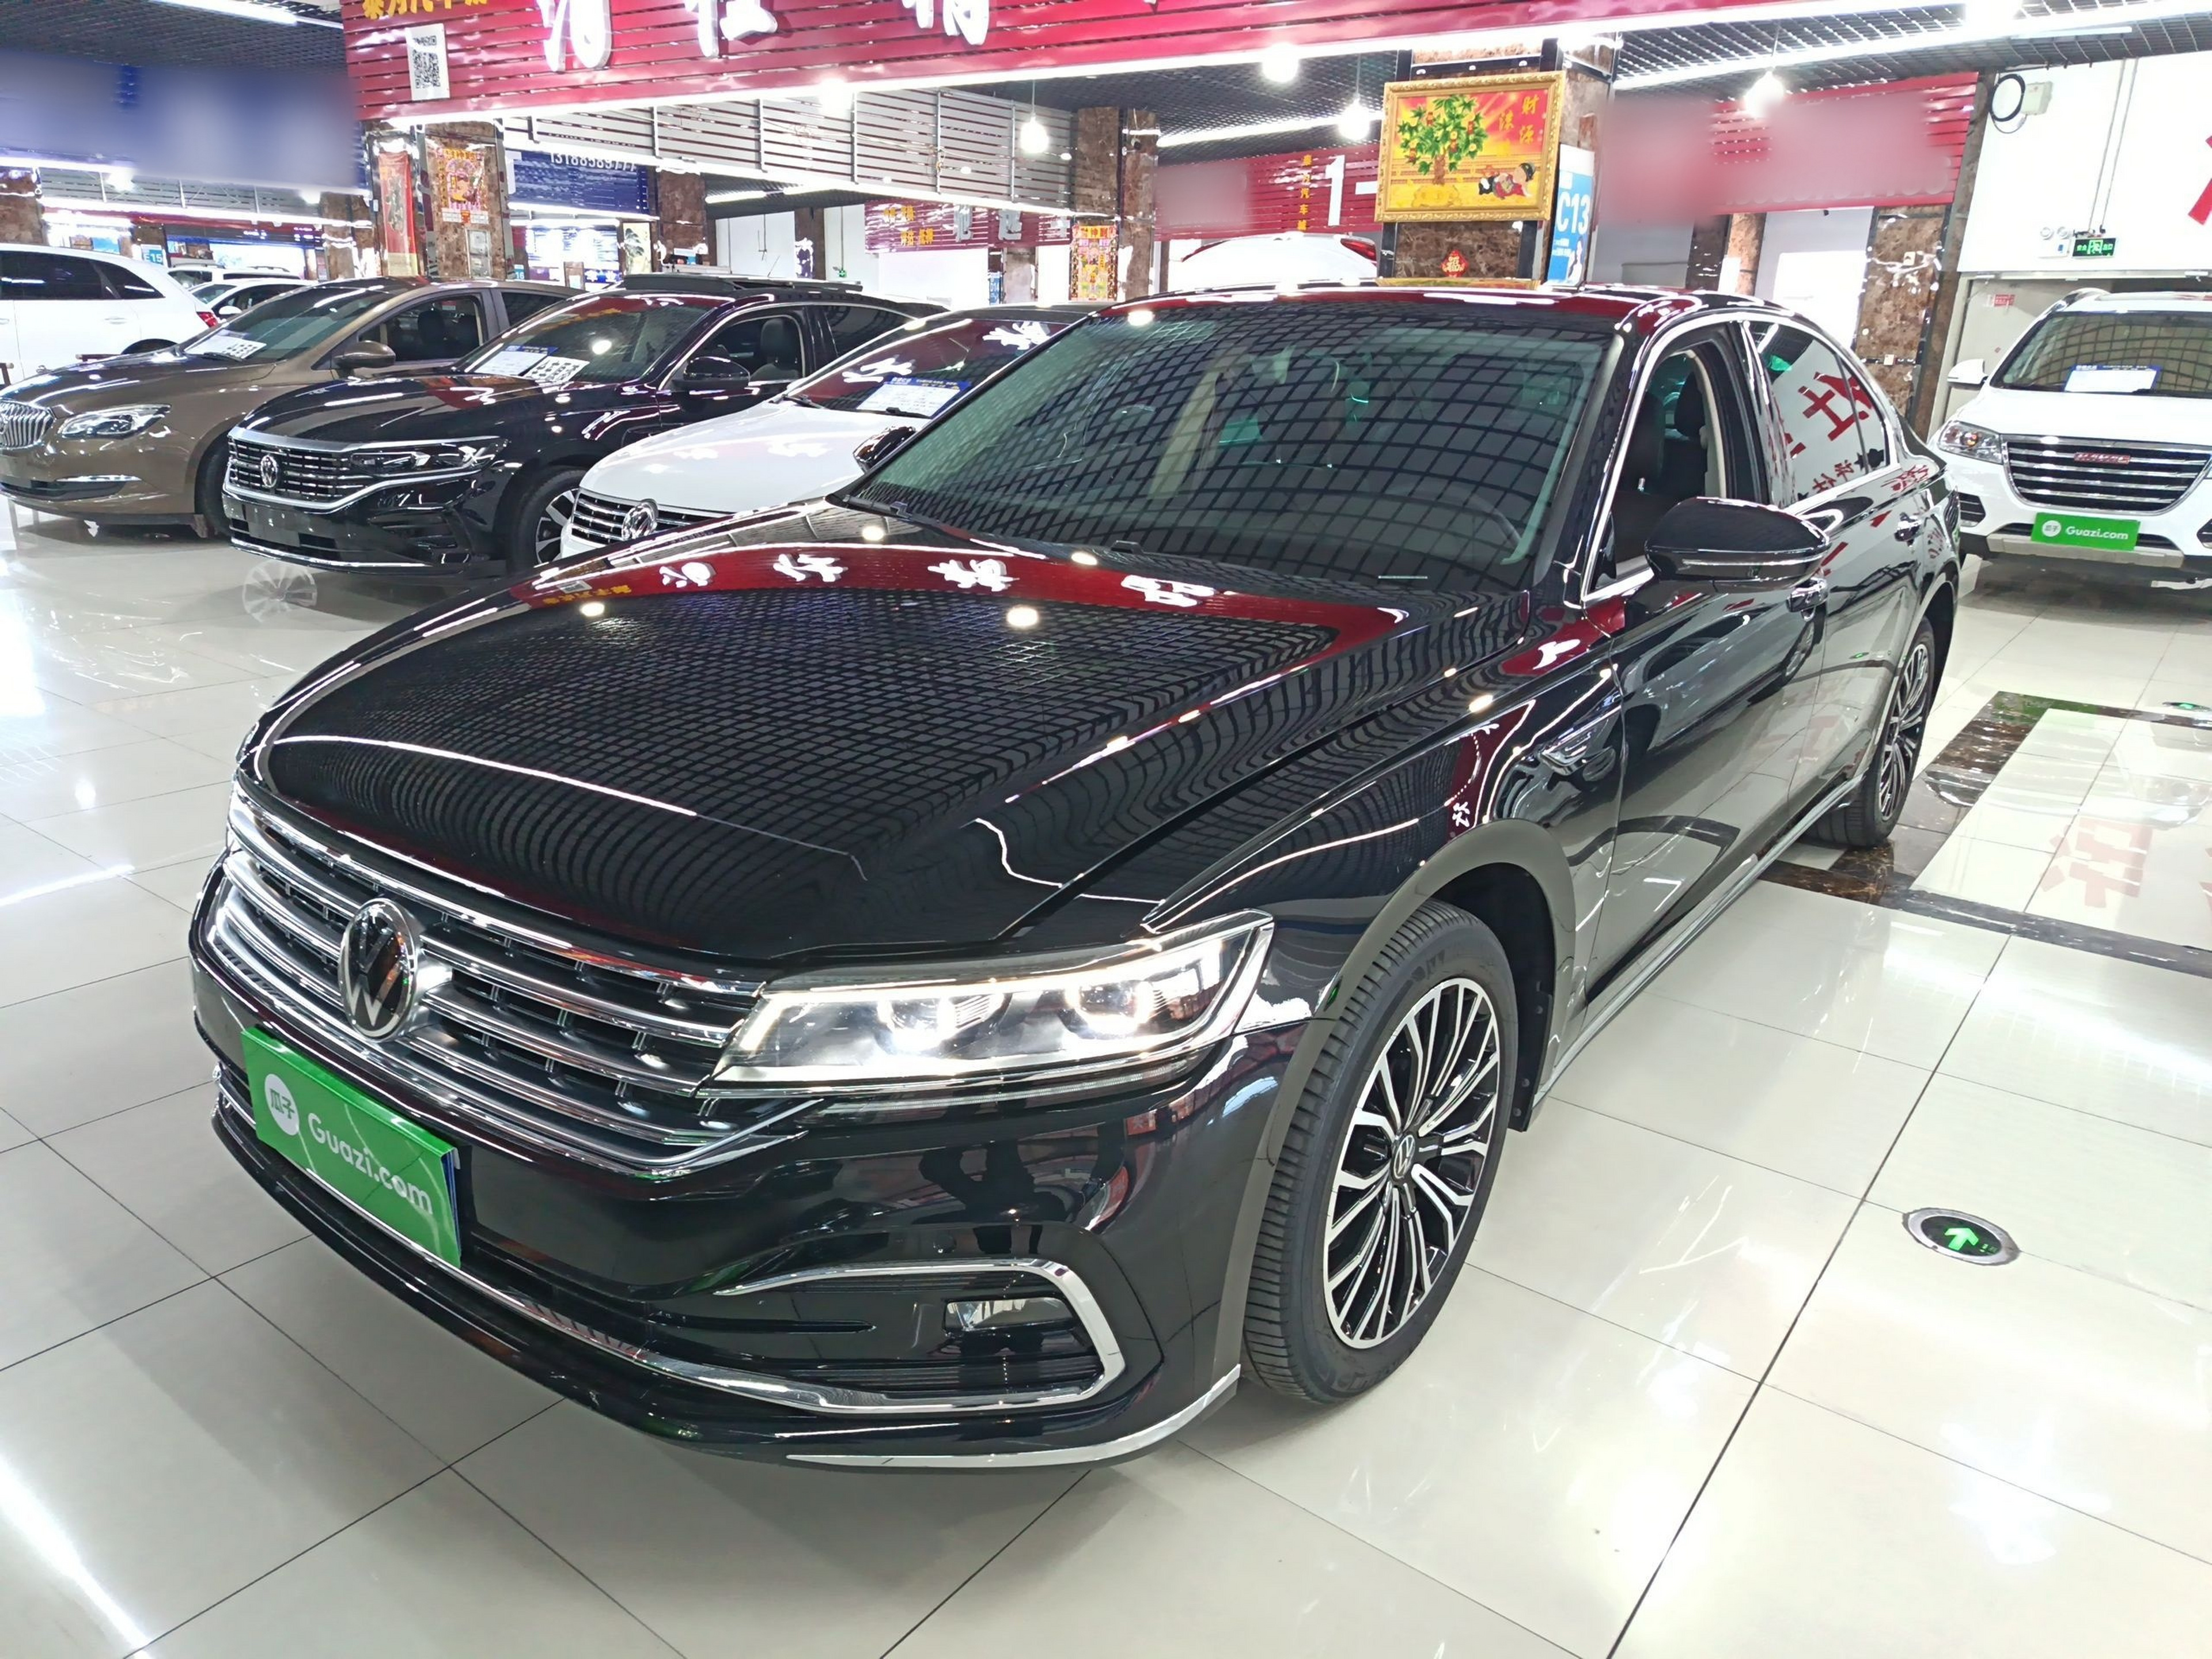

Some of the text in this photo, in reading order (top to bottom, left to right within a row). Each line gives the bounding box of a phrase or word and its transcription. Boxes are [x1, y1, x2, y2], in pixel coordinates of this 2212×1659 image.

[1556, 191, 1590, 234] C13
[143, 253, 163, 263] E15
[2065, 526, 2128, 540] Guazi.com
[269, 1088, 296, 1120] 瓜子
[308, 1112, 433, 1215] Guazi.com
